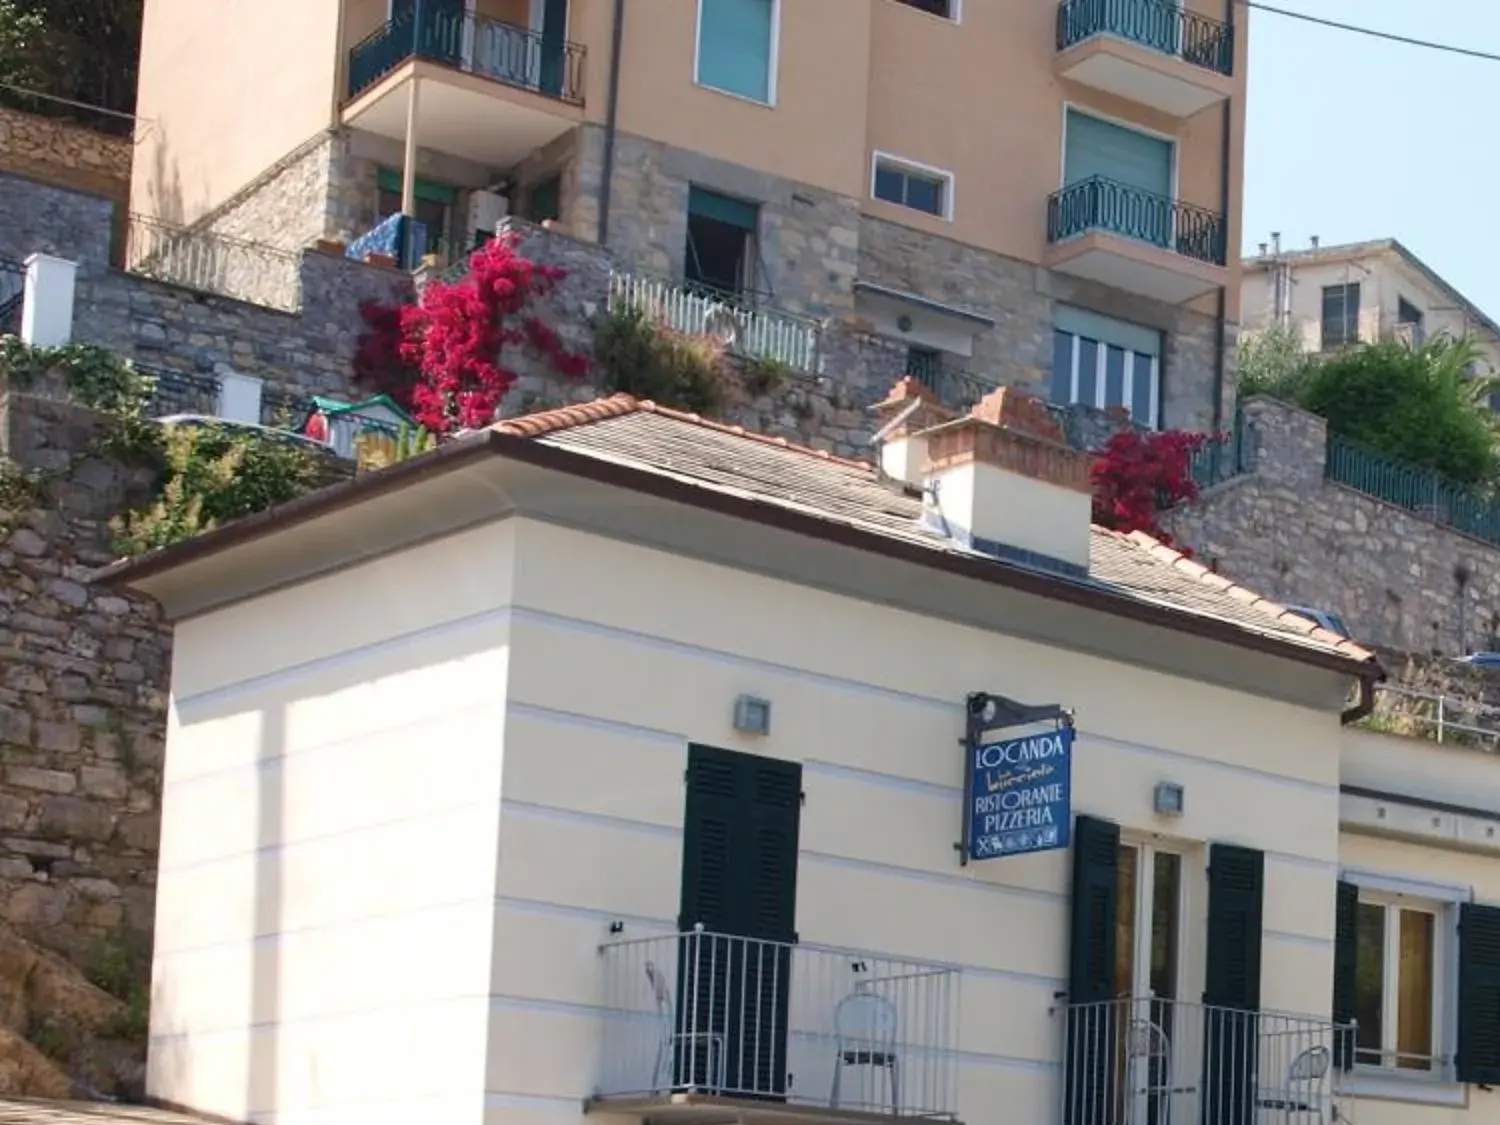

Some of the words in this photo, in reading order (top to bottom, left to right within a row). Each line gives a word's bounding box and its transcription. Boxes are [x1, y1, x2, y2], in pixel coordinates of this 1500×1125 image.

[975, 735, 1064, 769] LOCANDA
[975, 783, 1064, 814] RISTORANTE
[984, 806, 1053, 834] PIZZERIA
